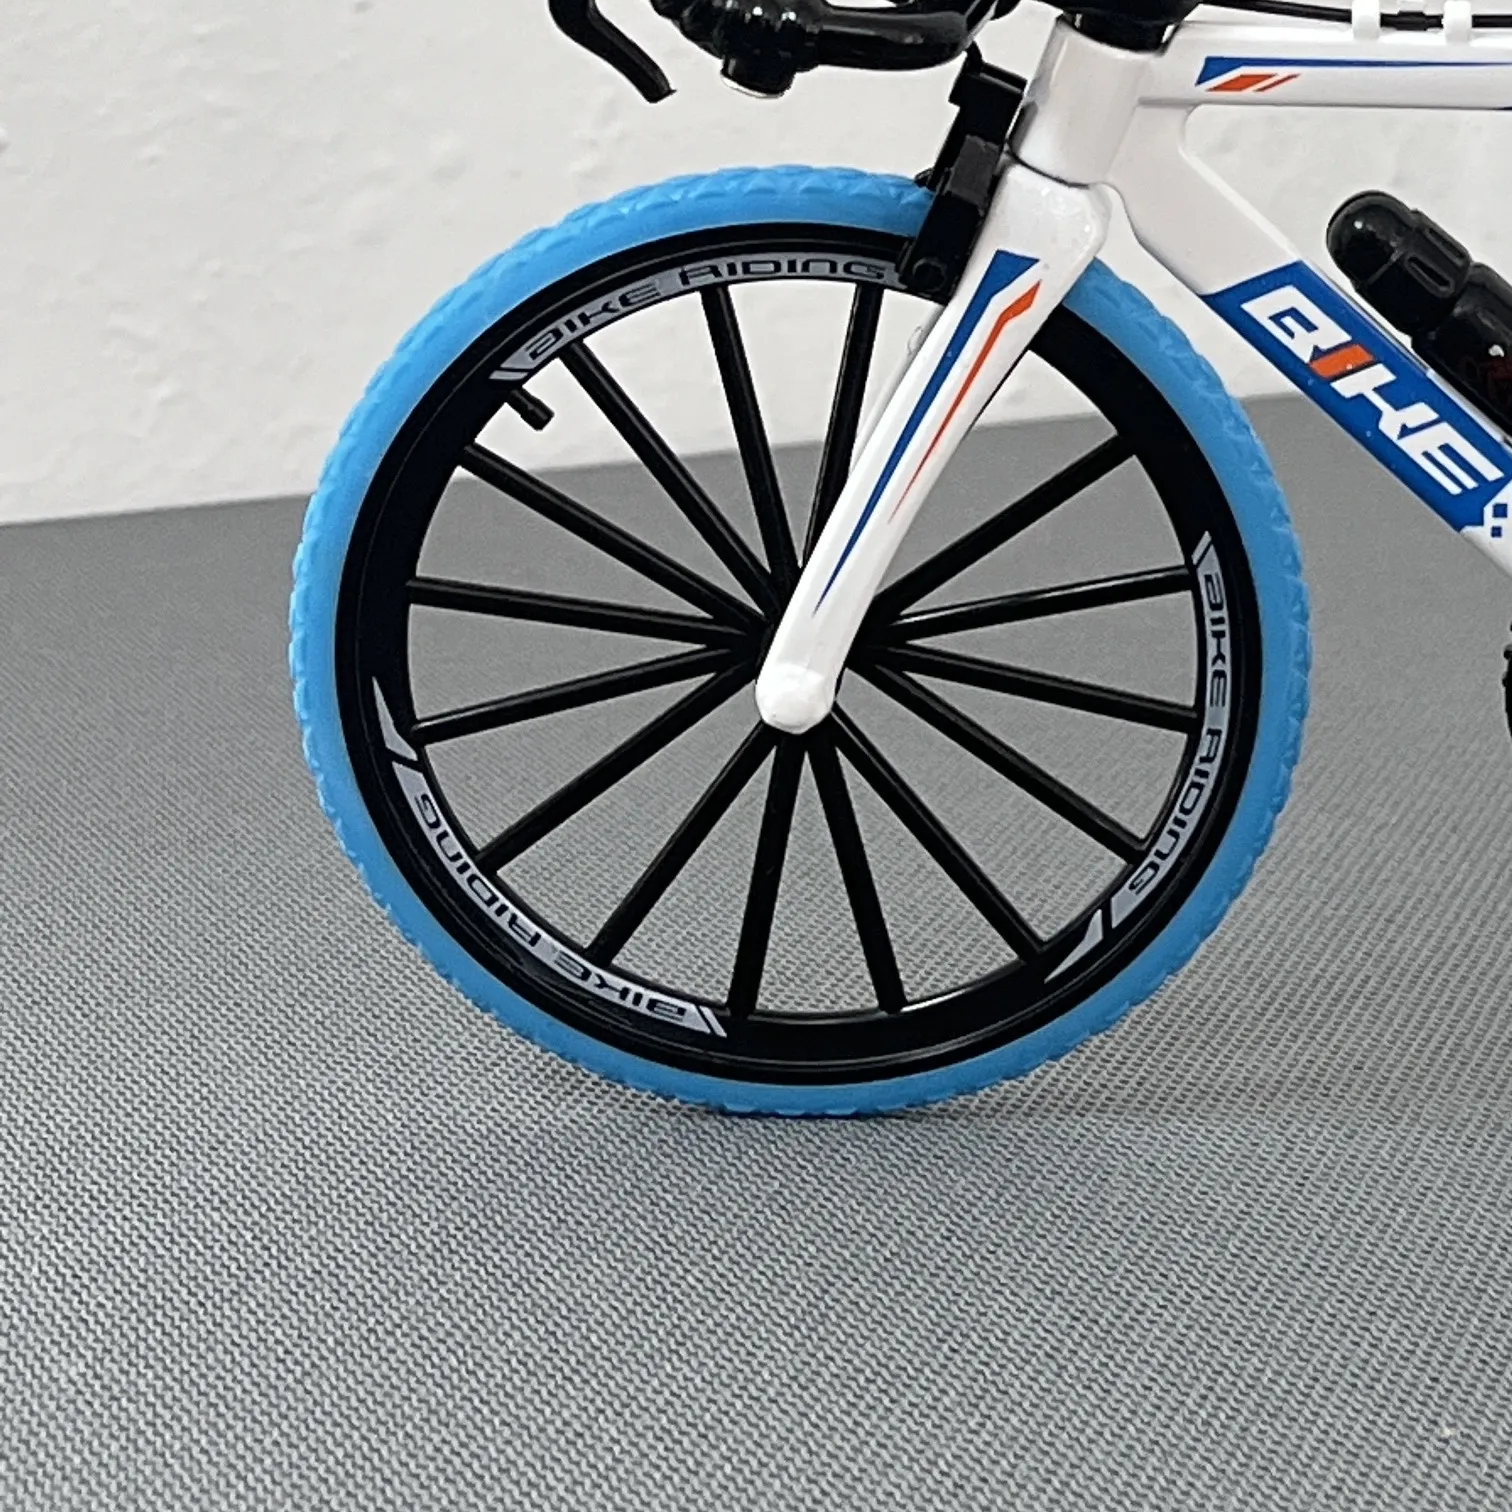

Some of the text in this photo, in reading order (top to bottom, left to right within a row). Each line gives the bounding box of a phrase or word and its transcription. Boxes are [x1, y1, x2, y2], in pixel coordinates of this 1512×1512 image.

[524, 257, 889, 361] BIKE RIDING
[1240, 284, 1504, 495] BIKE
[1127, 571, 1228, 896] BIKE RIDING
[413, 792, 688, 1022] BIKE RIDING
